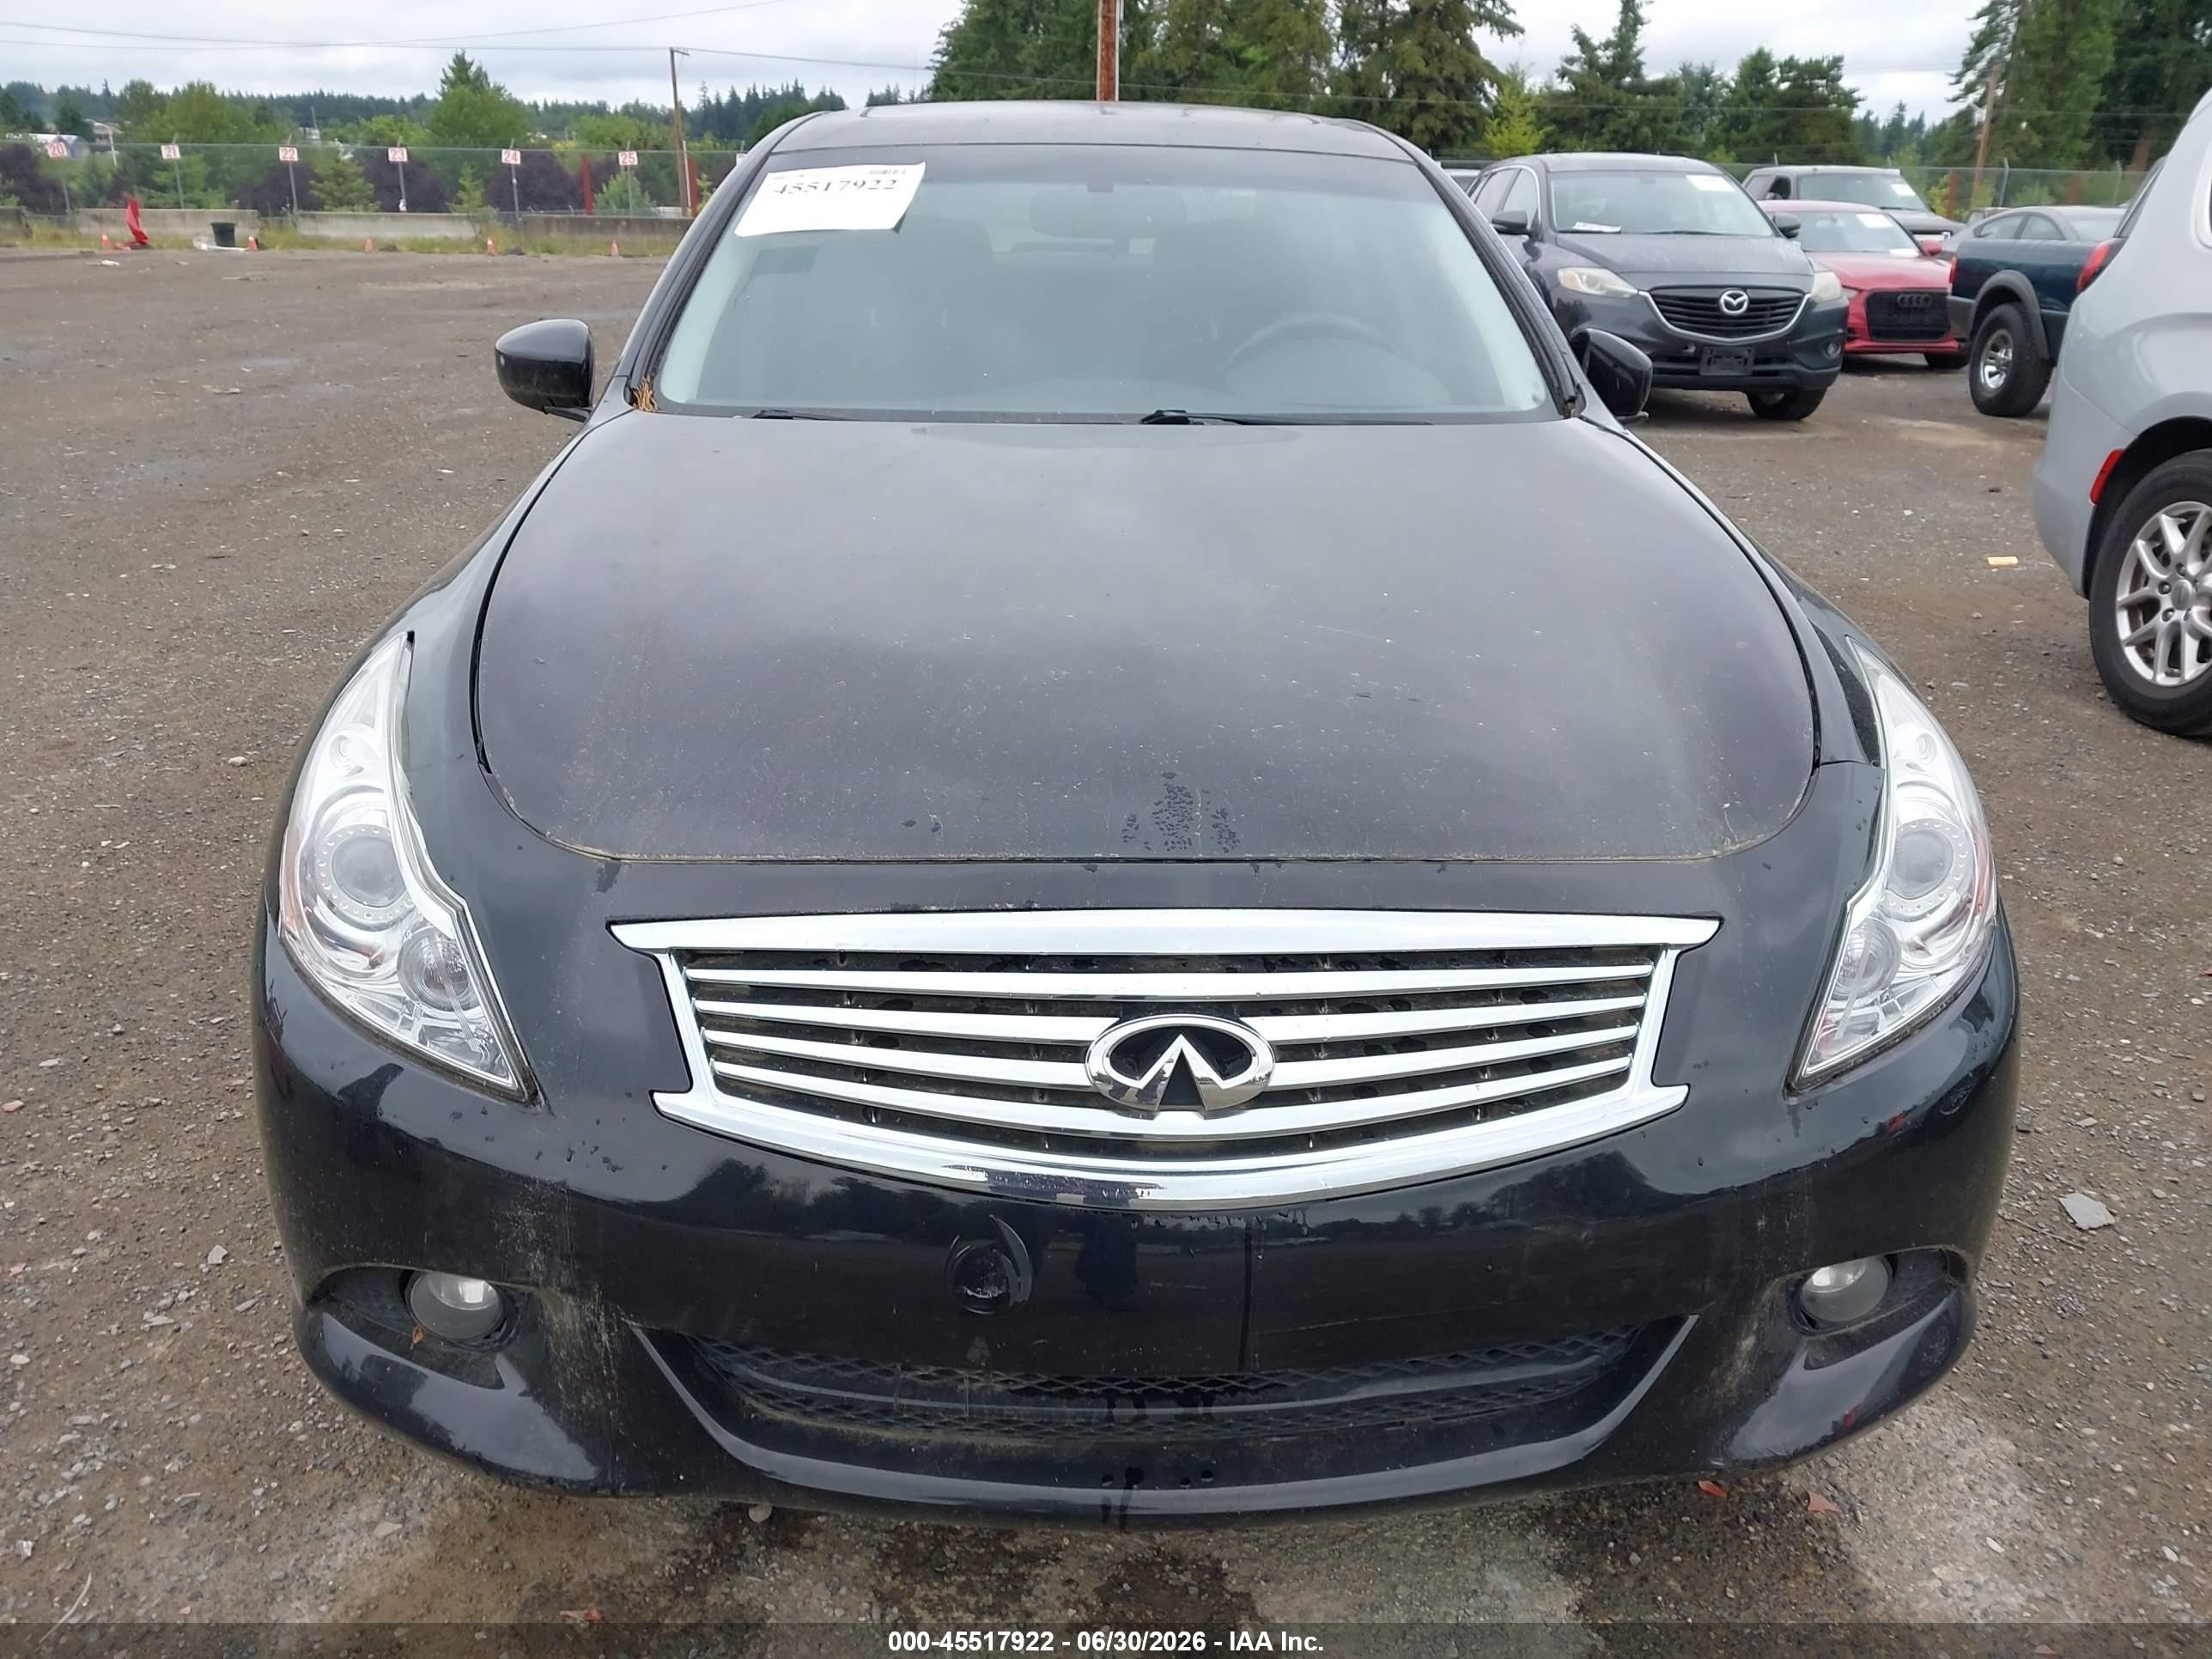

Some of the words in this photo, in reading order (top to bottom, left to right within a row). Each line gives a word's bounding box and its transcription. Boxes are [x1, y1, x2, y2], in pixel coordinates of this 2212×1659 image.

[50, 143, 64, 156] 20
[165, 144, 178, 157] 21
[282, 148, 296, 160] 22
[392, 149, 405, 160] 23
[503, 150, 518, 162] 24
[621, 152, 635, 164] 25
[774, 178, 897, 195] 45517922
